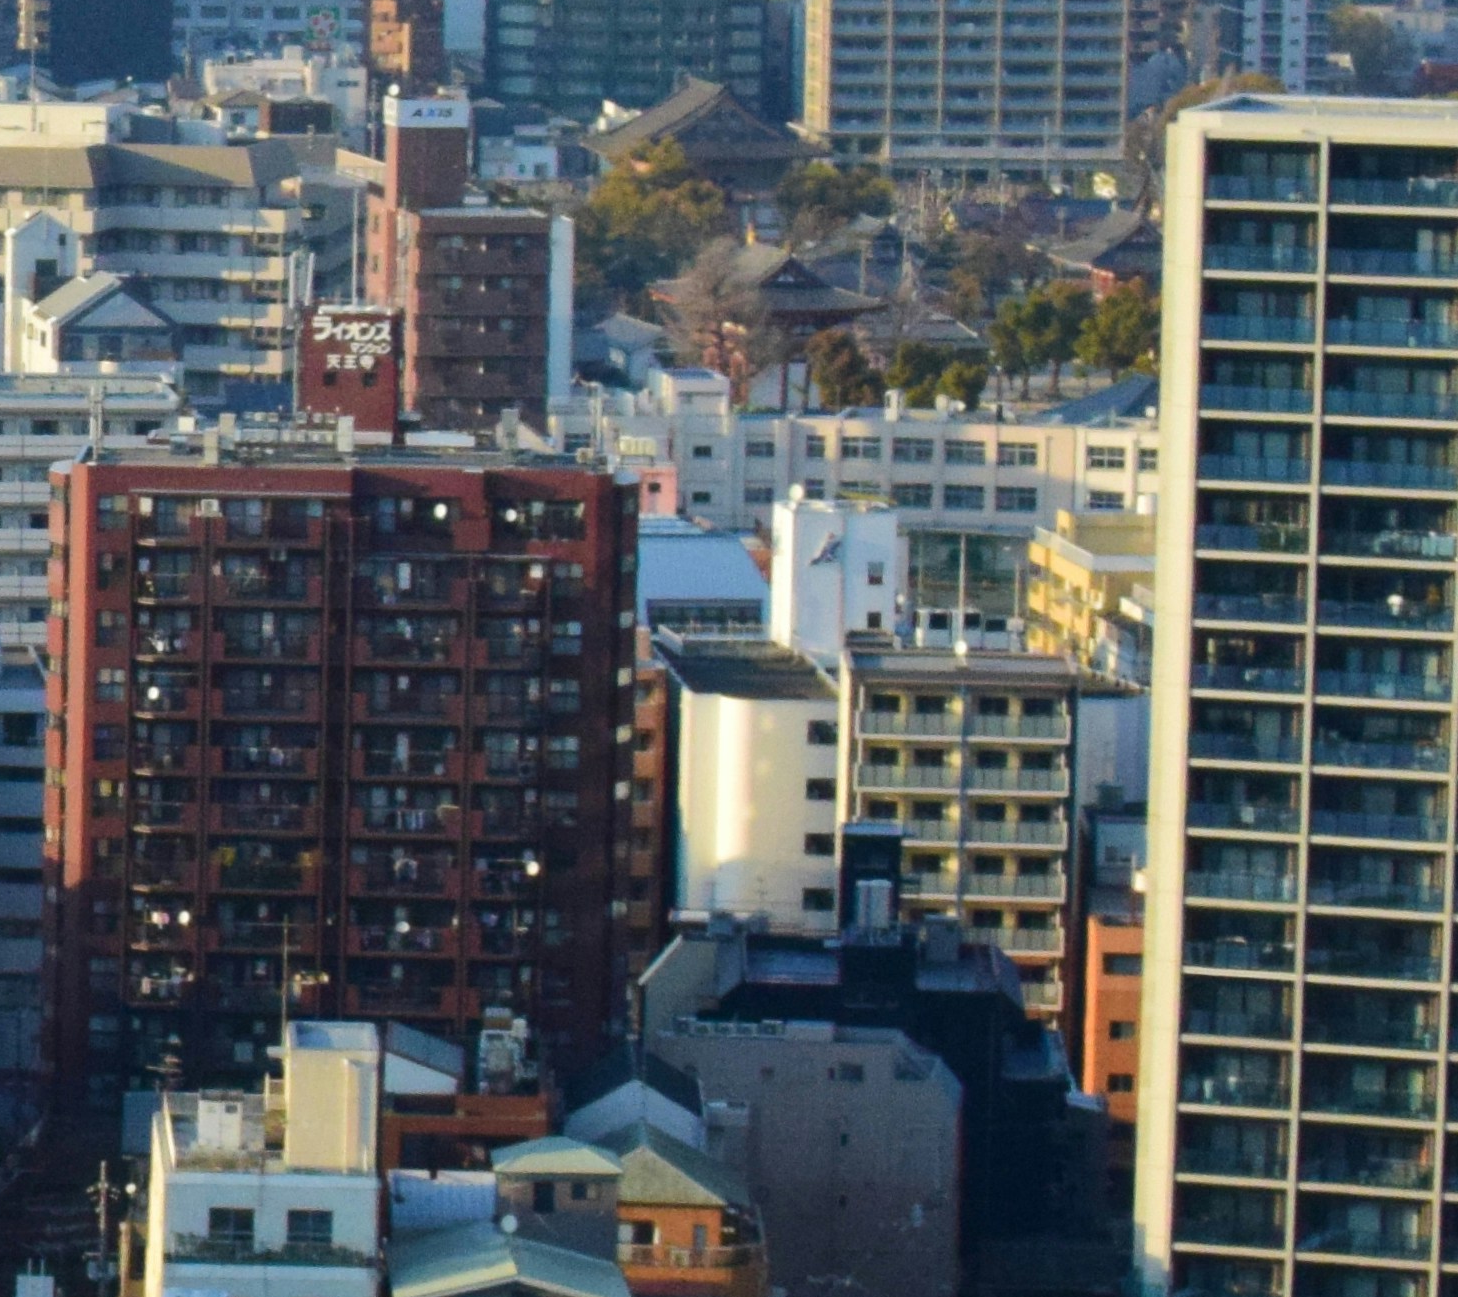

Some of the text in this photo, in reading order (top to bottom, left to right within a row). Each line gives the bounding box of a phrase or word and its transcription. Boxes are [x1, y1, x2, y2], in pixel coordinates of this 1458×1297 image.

[312, 316, 393, 342] ライオンズ
